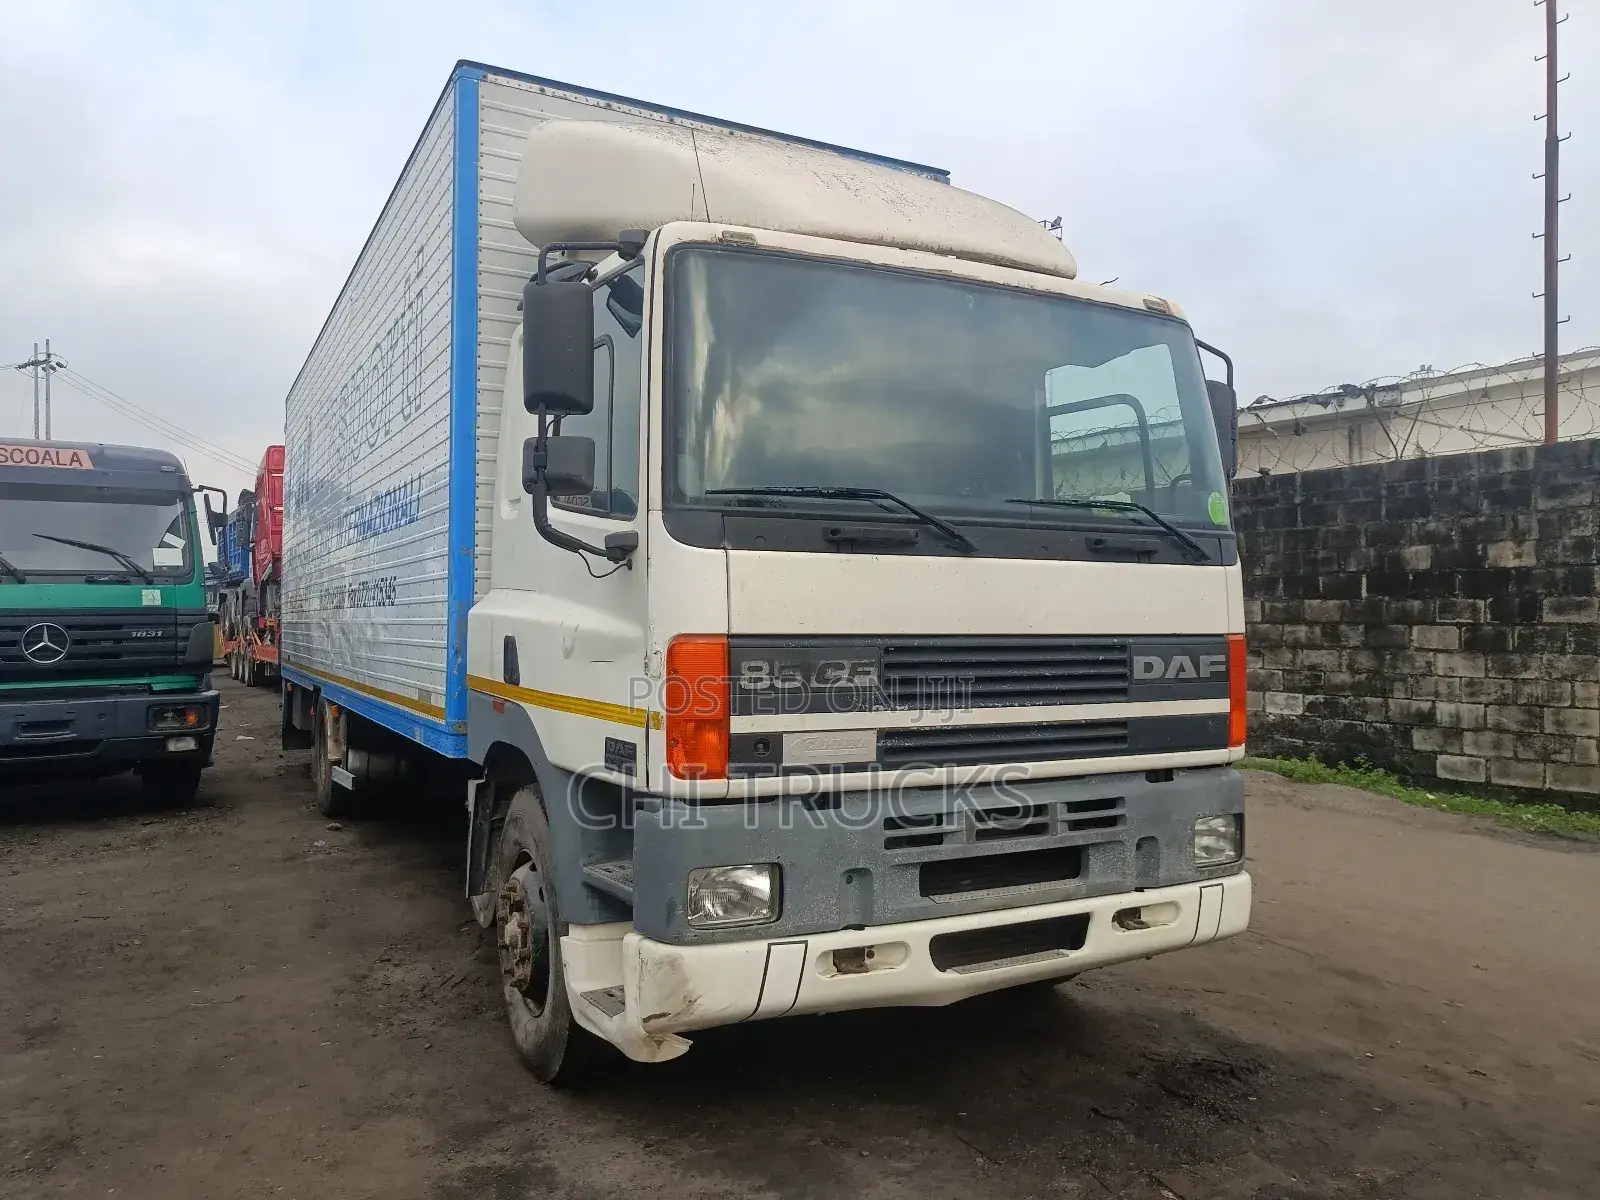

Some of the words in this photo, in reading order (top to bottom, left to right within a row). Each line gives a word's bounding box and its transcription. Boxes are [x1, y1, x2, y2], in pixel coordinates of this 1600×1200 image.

[0, 447, 84, 467] SCOALA
[740, 660, 803, 689] 85
[1133, 655, 1226, 680] DAF
